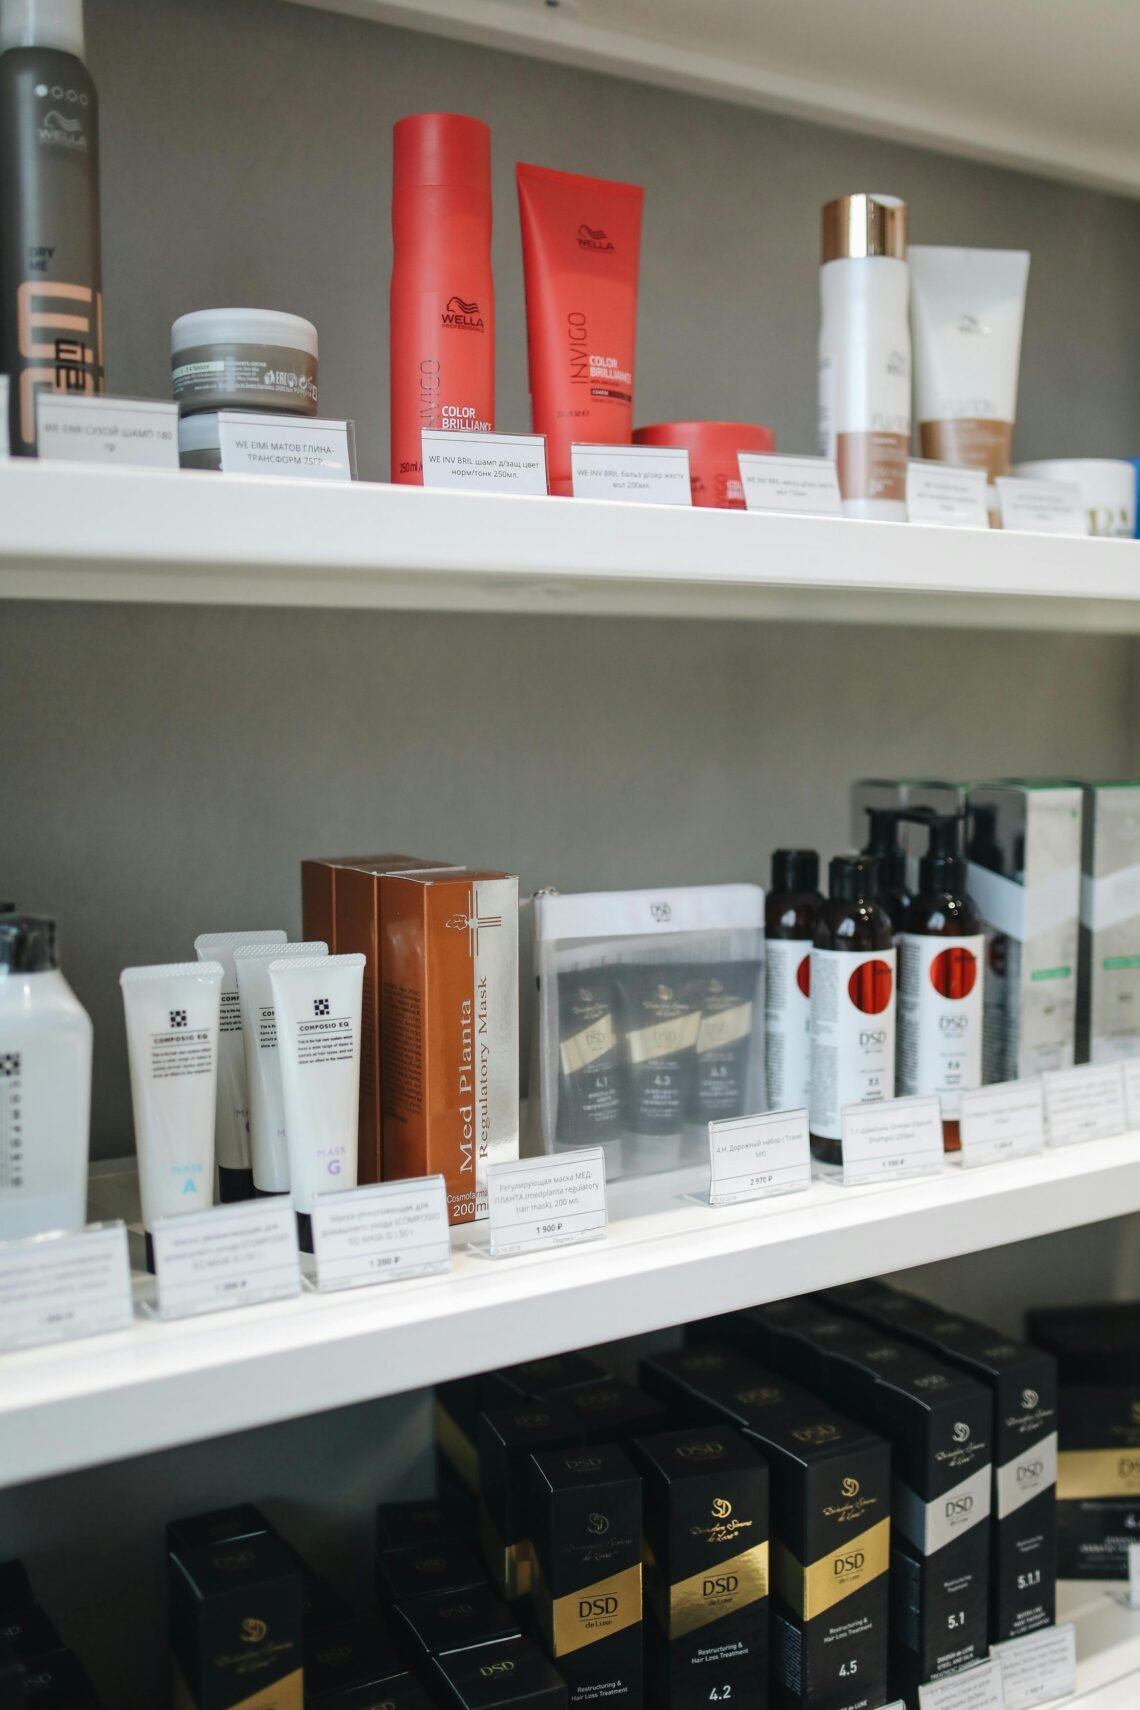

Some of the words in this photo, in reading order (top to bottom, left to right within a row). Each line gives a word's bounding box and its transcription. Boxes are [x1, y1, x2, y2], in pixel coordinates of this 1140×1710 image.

[577, 237, 615, 250] WELLA
[441, 314, 484, 328] WELLA
[568, 311, 589, 385] INVIGO
[589, 355, 618, 368] COLOR
[441, 405, 476, 419] COLOR
[235, 440, 249, 449] WE
[251, 441, 269, 450] EIMI
[271, 442, 301, 452] МАТОВ
[303, 444, 334, 454] ГЛИНА-
[247, 453, 302, 465] ТРАНСФОРМ
[443, 456, 456, 464] INV
[457, 457, 474, 465] BRIL
[451, 469, 492, 477] норм/тонк
[477, 976, 488, 1034] Mask
[299, 1022, 337, 1032] COMPOSIO
[939, 1015, 968, 1031] DSD
[153, 1034, 194, 1044] COMPOSIO
[458, 998, 473, 1096] Planta
[859, 1032, 888, 1047] DSD
[478, 1042, 490, 1159] Regulatory
[458, 1104, 473, 1175] Med
[316, 1145, 347, 1157] MASK
[327, 1159, 341, 1175] G
[182, 1178, 197, 1195] A
[500, 1178, 552, 1191] Регулирующая
[553, 1175, 574, 1183] маска
[565, 1182, 599, 1195] regulatory
[453, 1202, 475, 1217] 200
[542, 1224, 556, 1233] 900
[1016, 1460, 1044, 1482] DSD
[945, 1496, 973, 1518] DSD
[834, 1552, 865, 1576] DSD
[703, 1575, 738, 1597] DSD
[1016, 1568, 1041, 1590] 5.1.1
[579, 1597, 618, 1618] DSD
[829, 1620, 863, 1635] Restructuring
[947, 1611, 965, 1629] 5.1
[848, 1623, 873, 1636] Treatment
[691, 1656, 704, 1664] Hair
[705, 1654, 719, 1662] Loss
[720, 1647, 749, 1659] Treatment
[698, 1643, 737, 1657] Restructuring
[480, 1661, 515, 1677] DSD
[838, 1659, 858, 1678] 4.5
[571, 1694, 584, 1702] Hair
[585, 1691, 598, 1700] Loss
[599, 1686, 628, 1697] Treatment
[577, 1681, 616, 1694] Restructuring
[708, 1684, 732, 1701] 4.2
